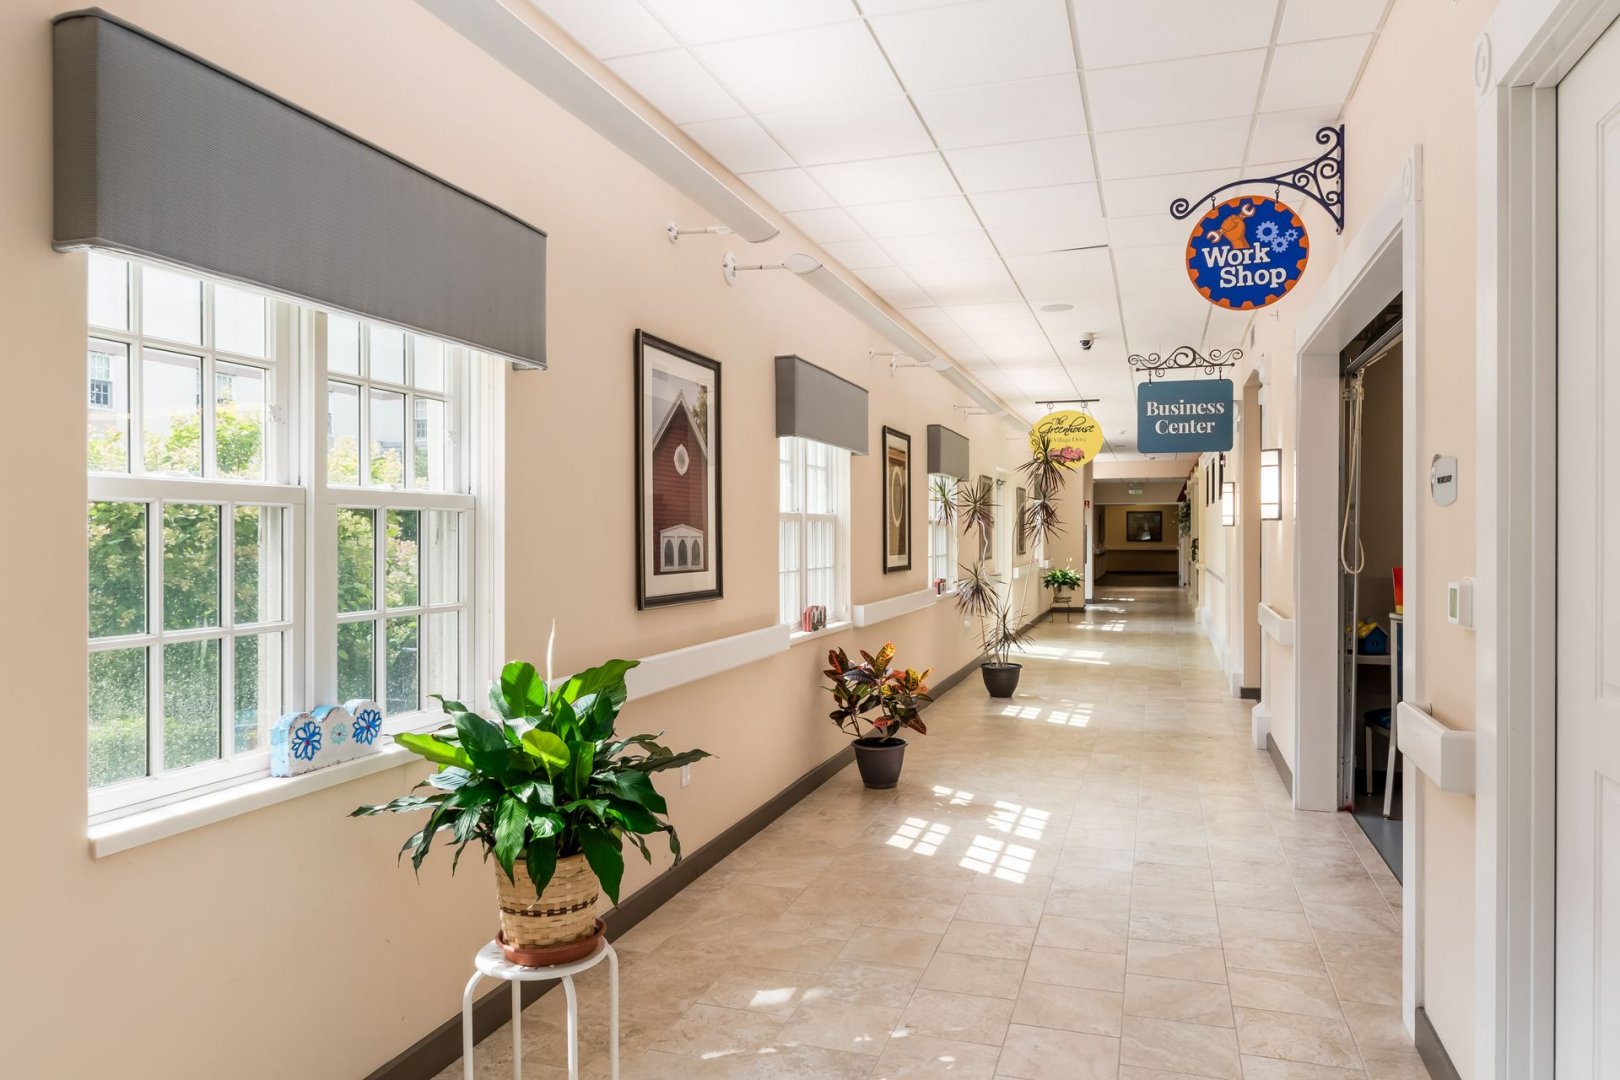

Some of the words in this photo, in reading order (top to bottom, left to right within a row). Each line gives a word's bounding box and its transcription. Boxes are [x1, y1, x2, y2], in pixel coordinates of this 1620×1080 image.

[1201, 242, 1271, 268] Work
[1219, 265, 1287, 288] Shop
[1146, 399, 1225, 416] Business
[1038, 416, 1095, 436] Greenhouse
[1052, 415, 1069, 425] The
[1155, 419, 1216, 435] Center
